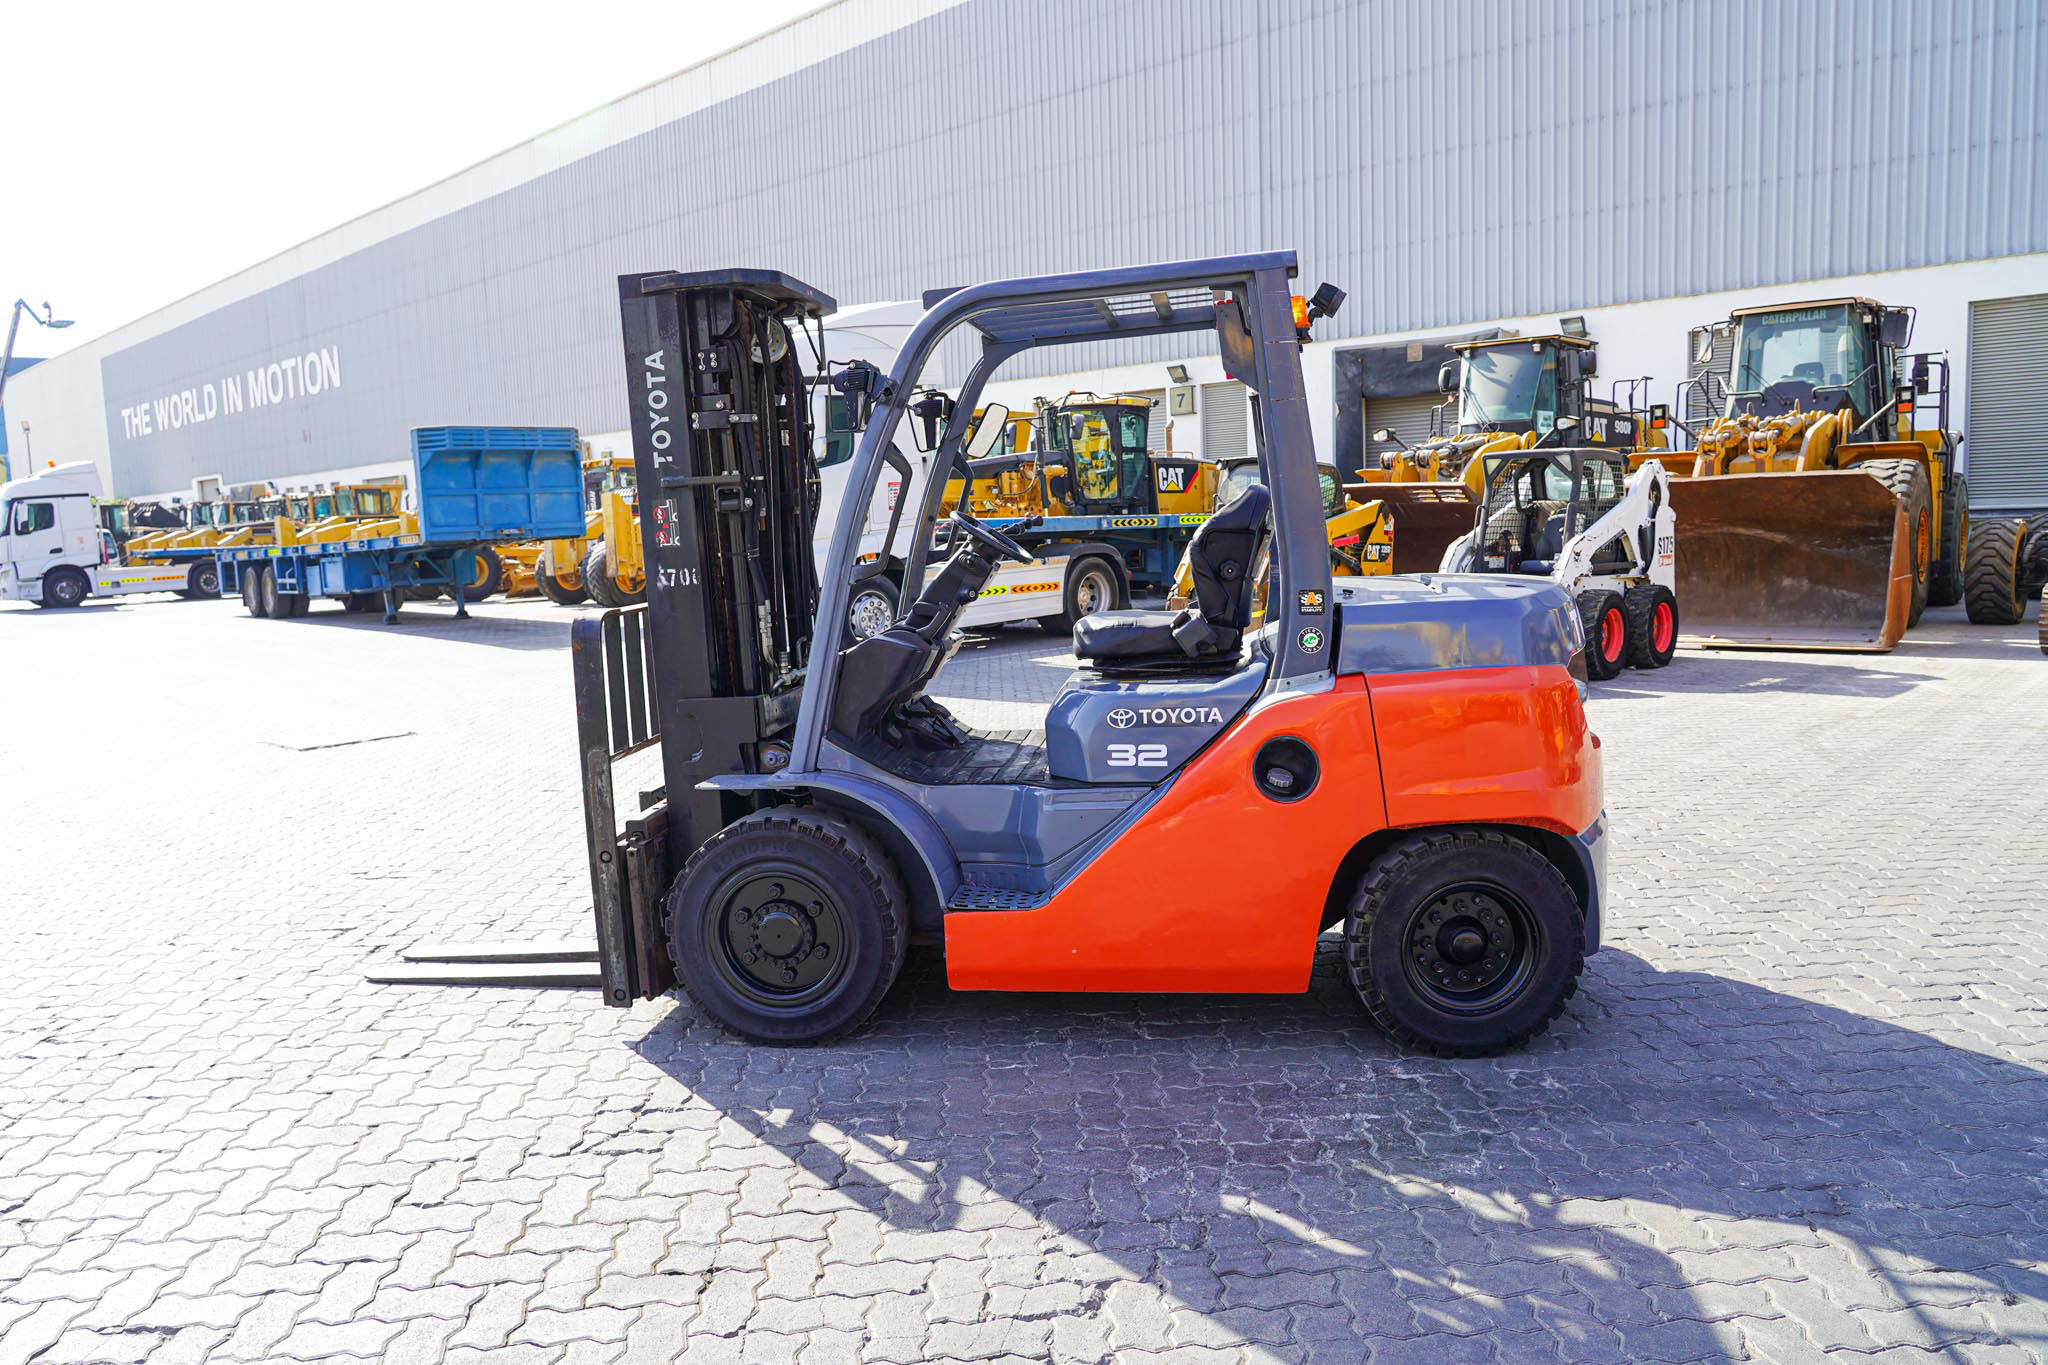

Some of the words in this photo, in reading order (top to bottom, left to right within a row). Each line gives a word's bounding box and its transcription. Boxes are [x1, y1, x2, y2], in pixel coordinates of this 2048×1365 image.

[1762, 309, 1827, 325] CATERPILLAR
[121, 402, 152, 439] THE
[153, 383, 218, 432] WORLD
[221, 375, 243, 416] IN
[247, 345, 341, 409] MOTION
[1176, 393, 1186, 409] 7
[644, 349, 673, 469] TOYOTA
[1584, 415, 1608, 443] CAT
[1158, 467, 1185, 492] CAT
[1367, 544, 1380, 560] CAT
[1658, 536, 1673, 555] S175
[1300, 591, 1323, 606] SAS
[1301, 628, 1316, 636] TIER
[1139, 707, 1223, 724] TOYOTA
[1107, 744, 1168, 766] 32
